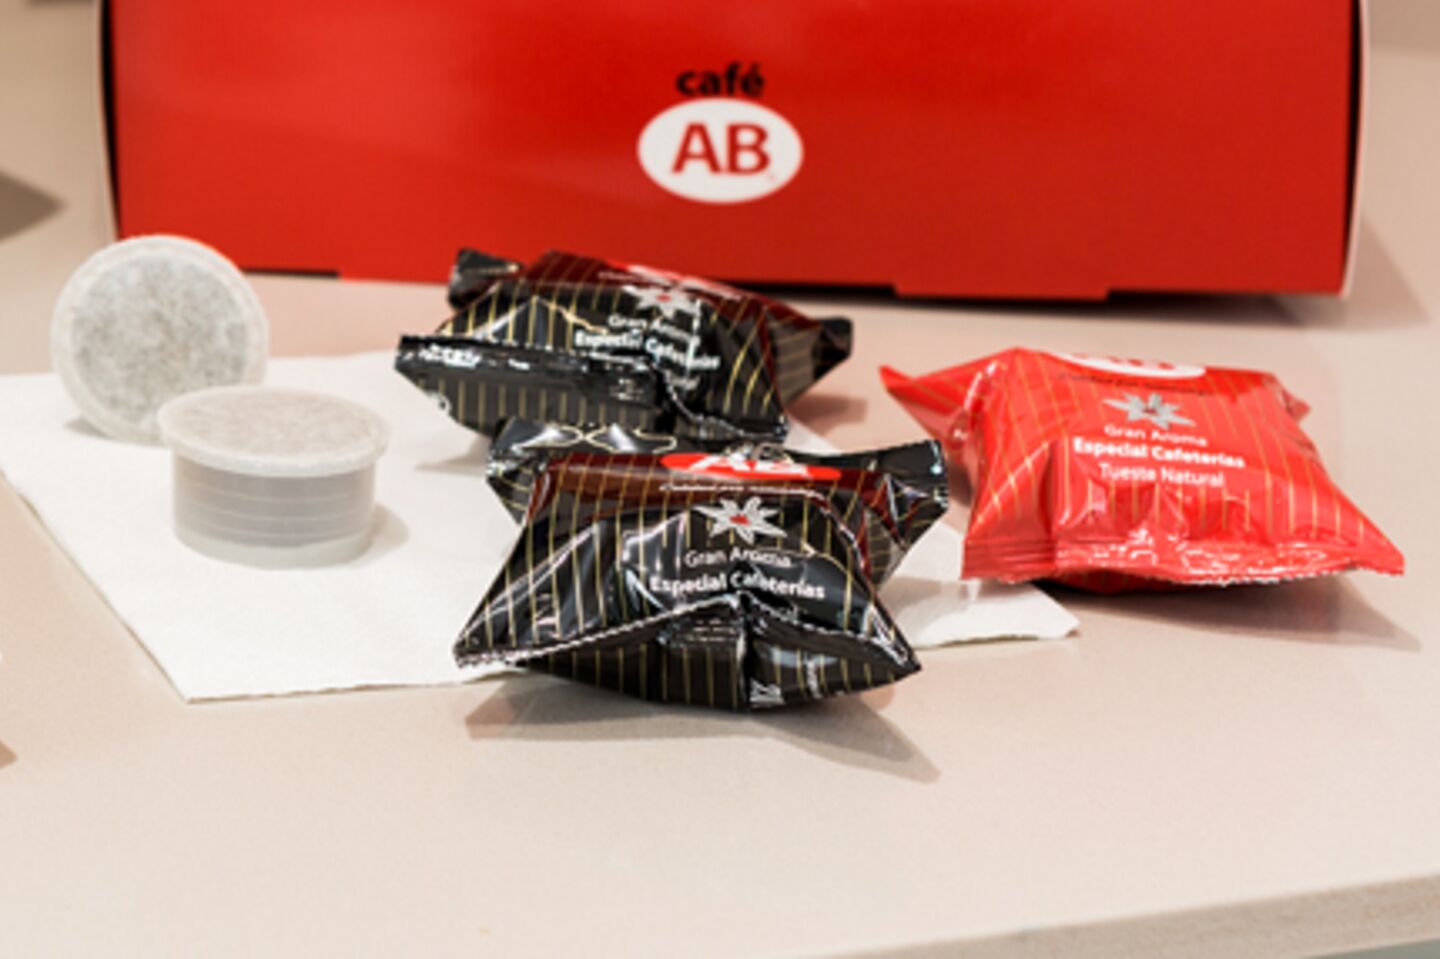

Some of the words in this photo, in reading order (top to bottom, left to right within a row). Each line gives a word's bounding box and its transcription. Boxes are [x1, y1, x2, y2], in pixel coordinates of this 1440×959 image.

[676, 61, 765, 98] café
[671, 122, 771, 176] AB
[1073, 437, 1147, 458] Especial
[684, 548, 727, 568] Gran
[648, 571, 727, 598] Especial
